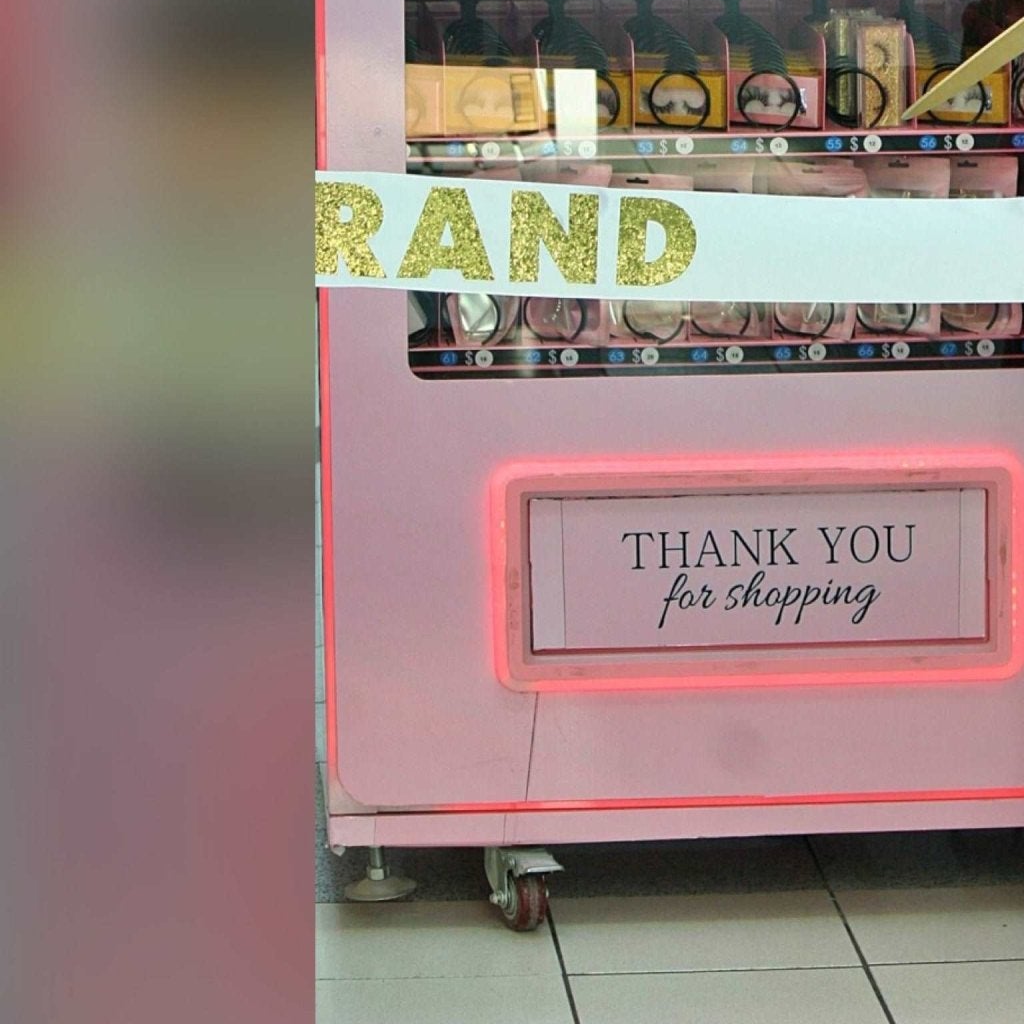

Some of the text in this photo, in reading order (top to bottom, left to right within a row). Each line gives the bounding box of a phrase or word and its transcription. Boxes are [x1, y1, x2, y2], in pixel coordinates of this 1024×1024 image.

[638, 142, 652, 152] 53
[660, 139, 668, 154] $
[732, 141, 746, 151] 54
[754, 139, 763, 153] $
[827, 139, 841, 149] 55
[850, 137, 858, 151] $
[921, 138, 935, 148] 56
[944, 135, 952, 149] $
[315, 181, 697, 287] RAND
[692, 350, 706, 360] 64
[716, 348, 724, 362] $
[776, 348, 790, 358] 65
[799, 345, 807, 360] $
[859, 346, 873, 356] 66
[882, 343, 890, 357] $
[942, 344, 956, 354] 67
[965, 341, 973, 355] $
[442, 353, 456, 363] 61
[465, 351, 473, 365] $
[548, 350, 557, 364] $
[610, 351, 624, 361] 63
[632, 349, 640, 363] $
[621, 525, 916, 570] THANK YOU
[658, 570, 881, 629] for shopping
